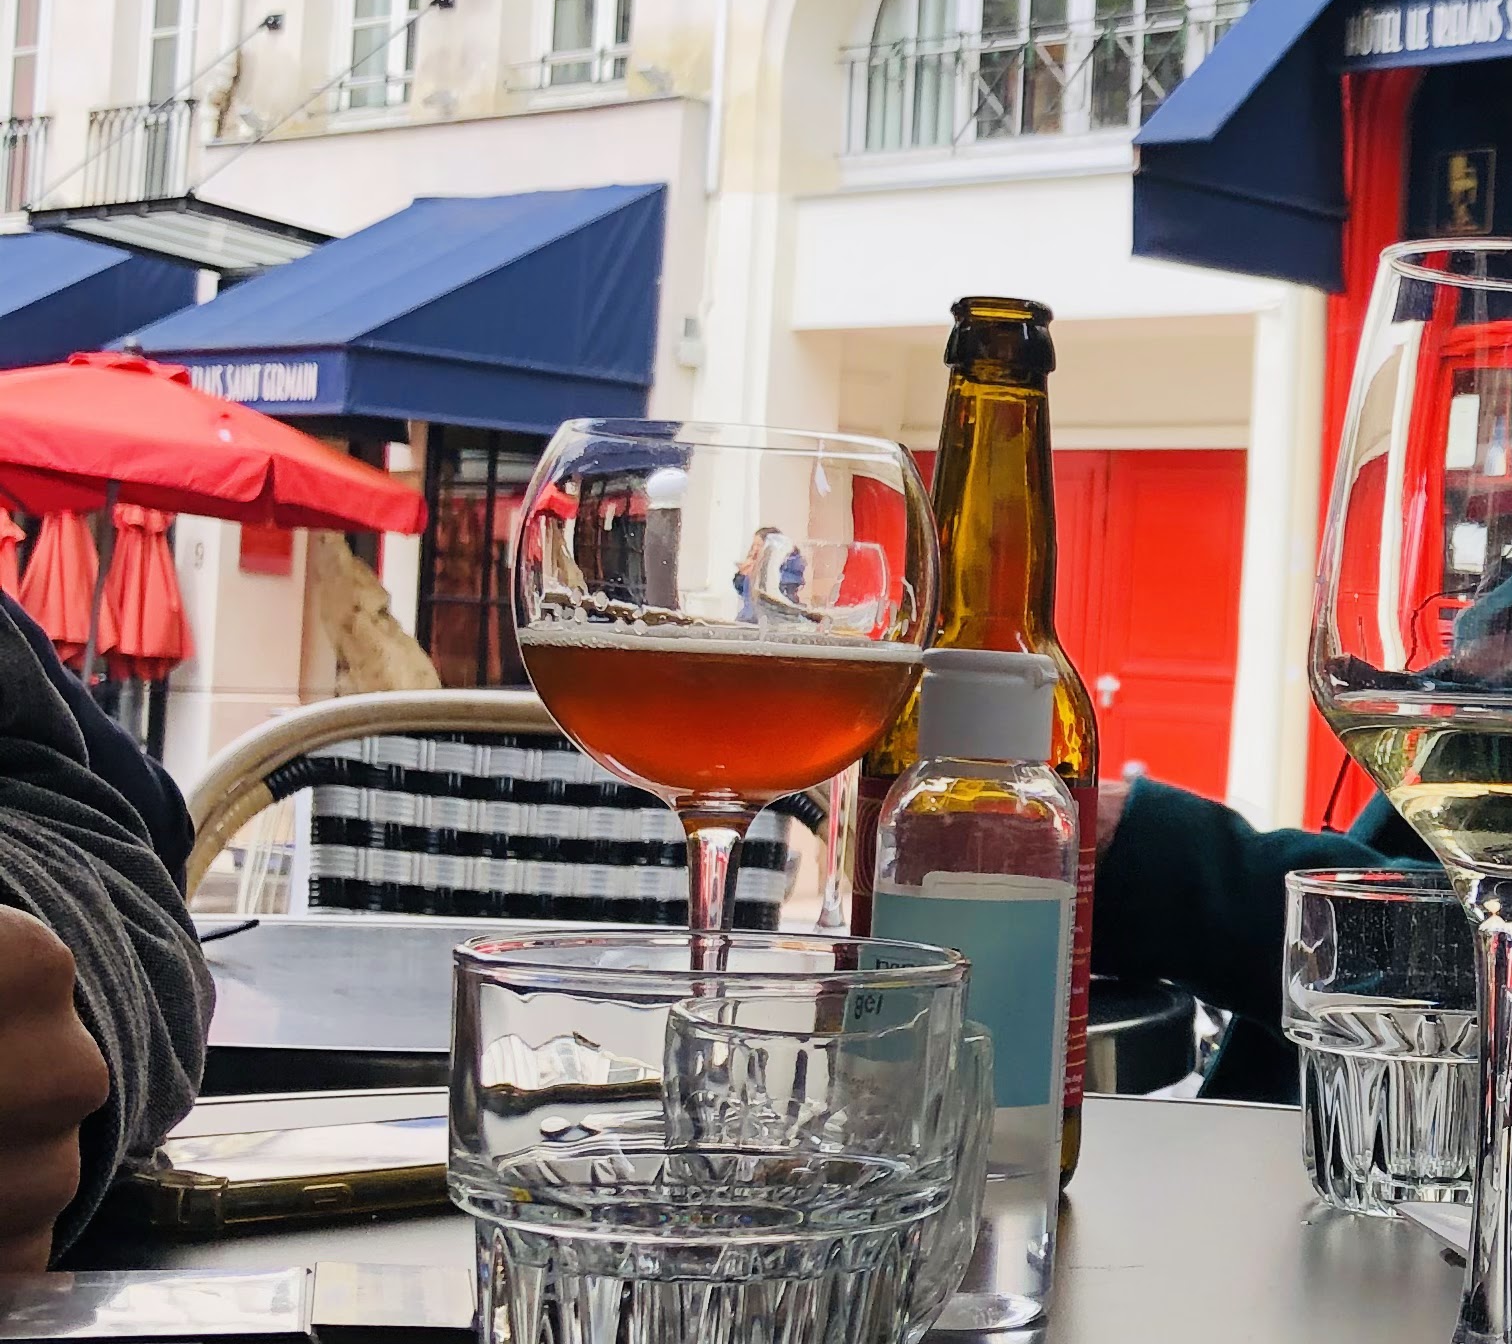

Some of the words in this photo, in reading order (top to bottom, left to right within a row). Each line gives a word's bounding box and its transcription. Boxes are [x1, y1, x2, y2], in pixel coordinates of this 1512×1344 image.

[1404, 6, 1431, 52] LE
[225, 363, 261, 402] SAINT
[262, 361, 318, 402] GERMAIN
